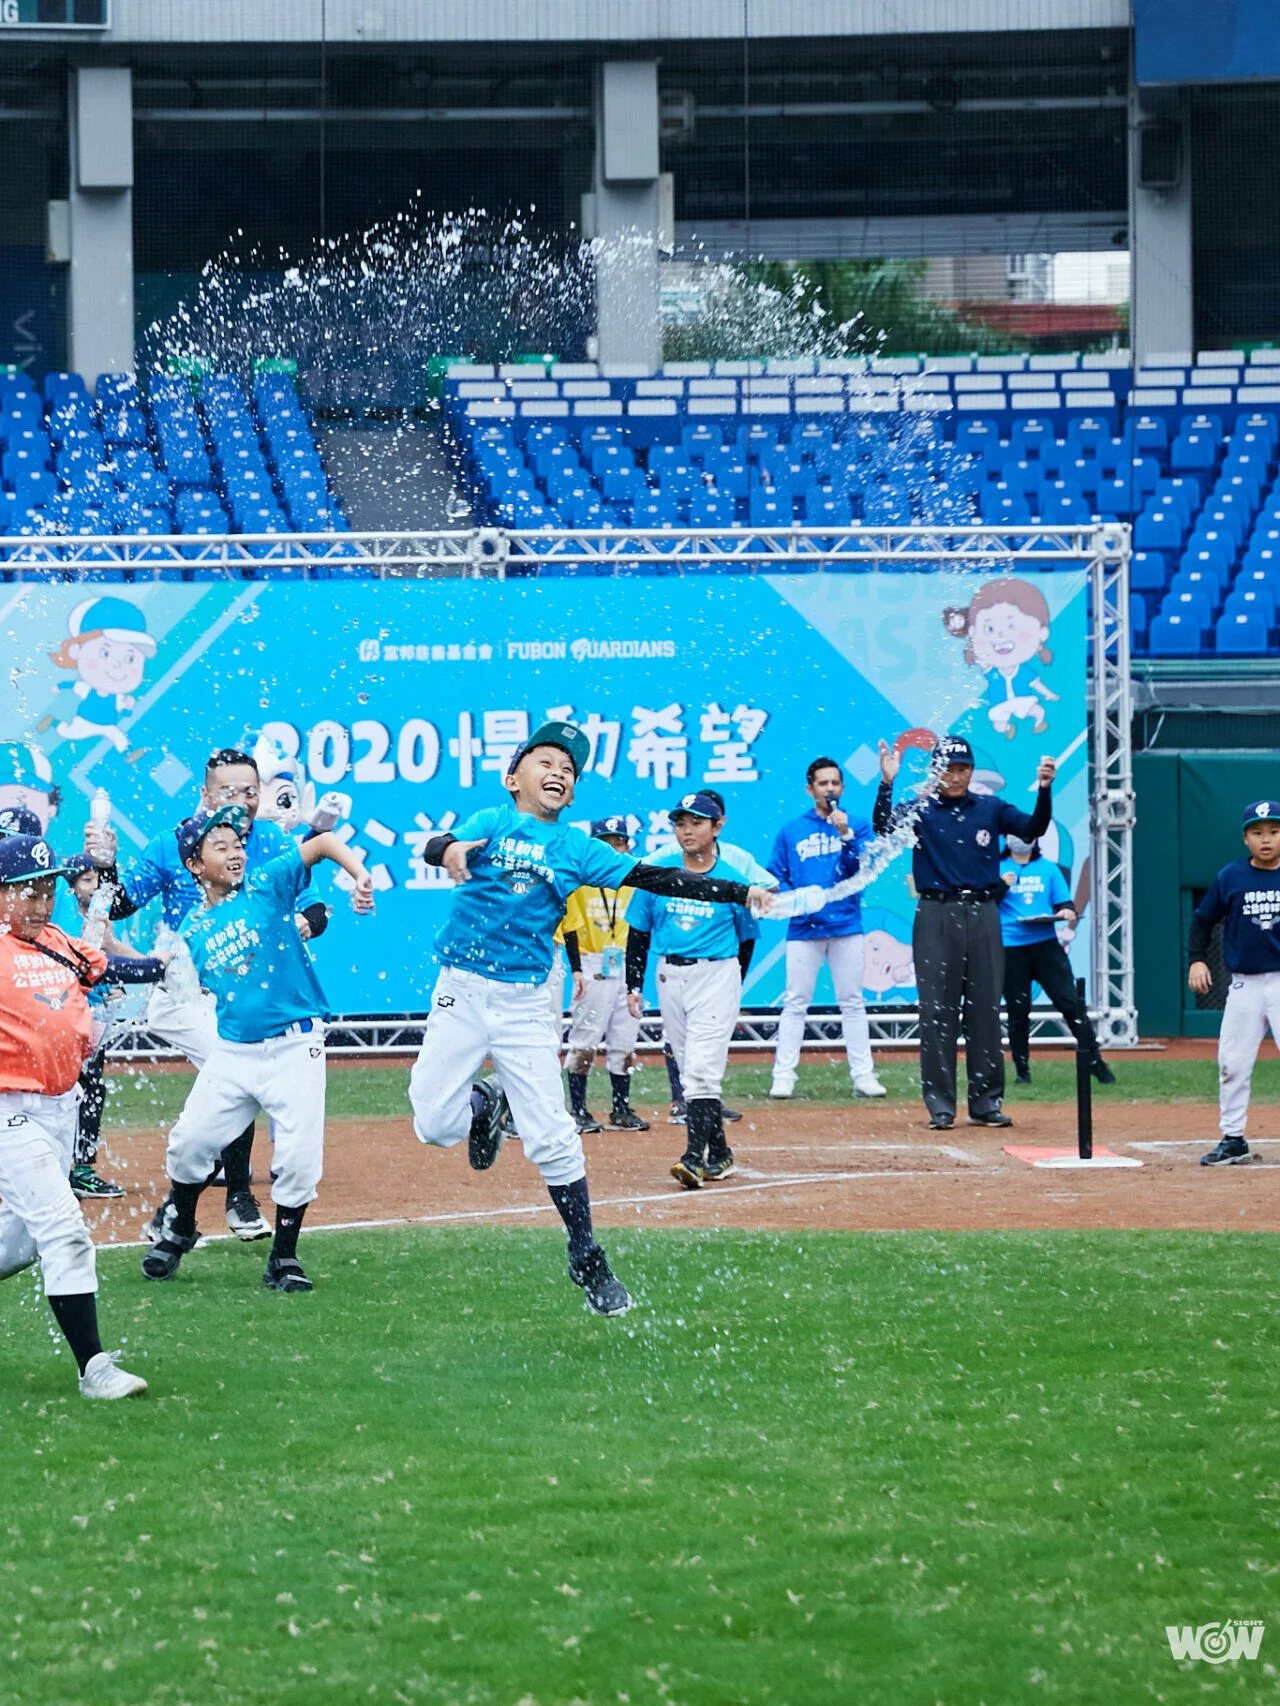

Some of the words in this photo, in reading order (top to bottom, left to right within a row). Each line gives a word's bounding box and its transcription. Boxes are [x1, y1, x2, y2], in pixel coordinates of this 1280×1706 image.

[507, 641, 566, 660] FUBON
[570, 637, 674, 662] GUARDIANS
[499, 836, 546, 861] 悍動希
[512, 871, 531, 879] 2020
